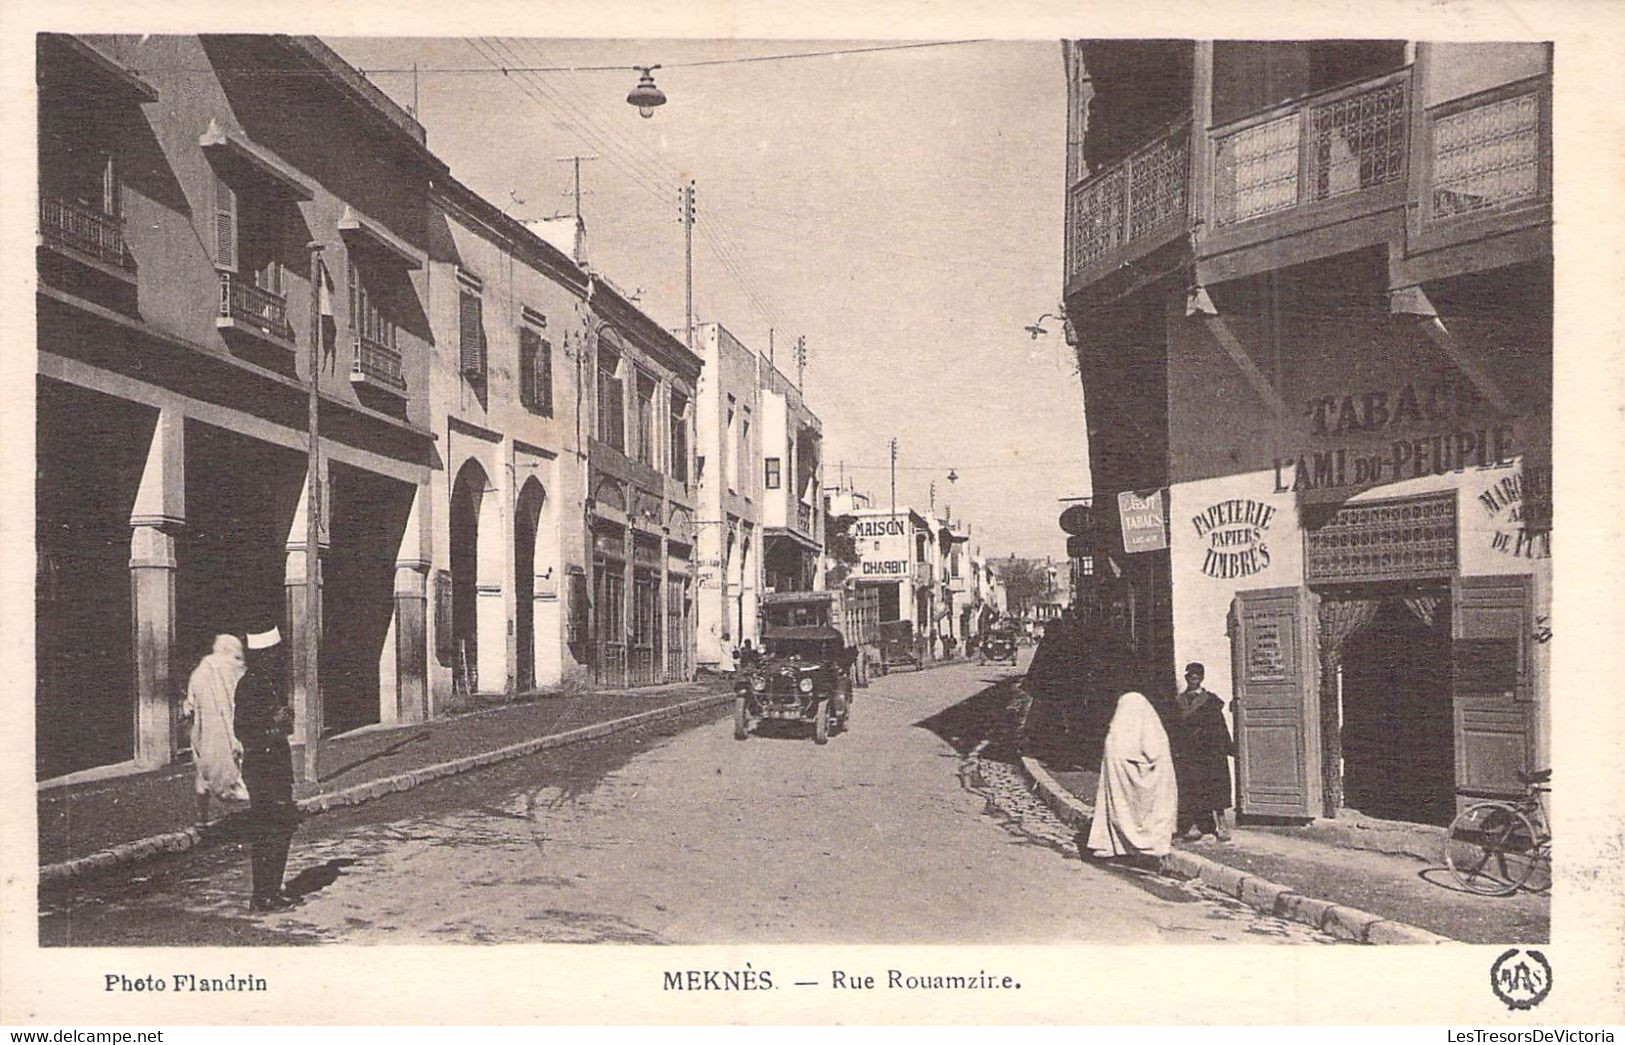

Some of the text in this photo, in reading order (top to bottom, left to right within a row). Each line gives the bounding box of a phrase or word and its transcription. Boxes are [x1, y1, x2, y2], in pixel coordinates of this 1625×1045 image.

[855, 521, 905, 536] MAISON
[1192, 500, 1277, 539] PAPETERIE
[1211, 527, 1261, 548] PAPIERS
[863, 561, 907, 574] CHARBIT
